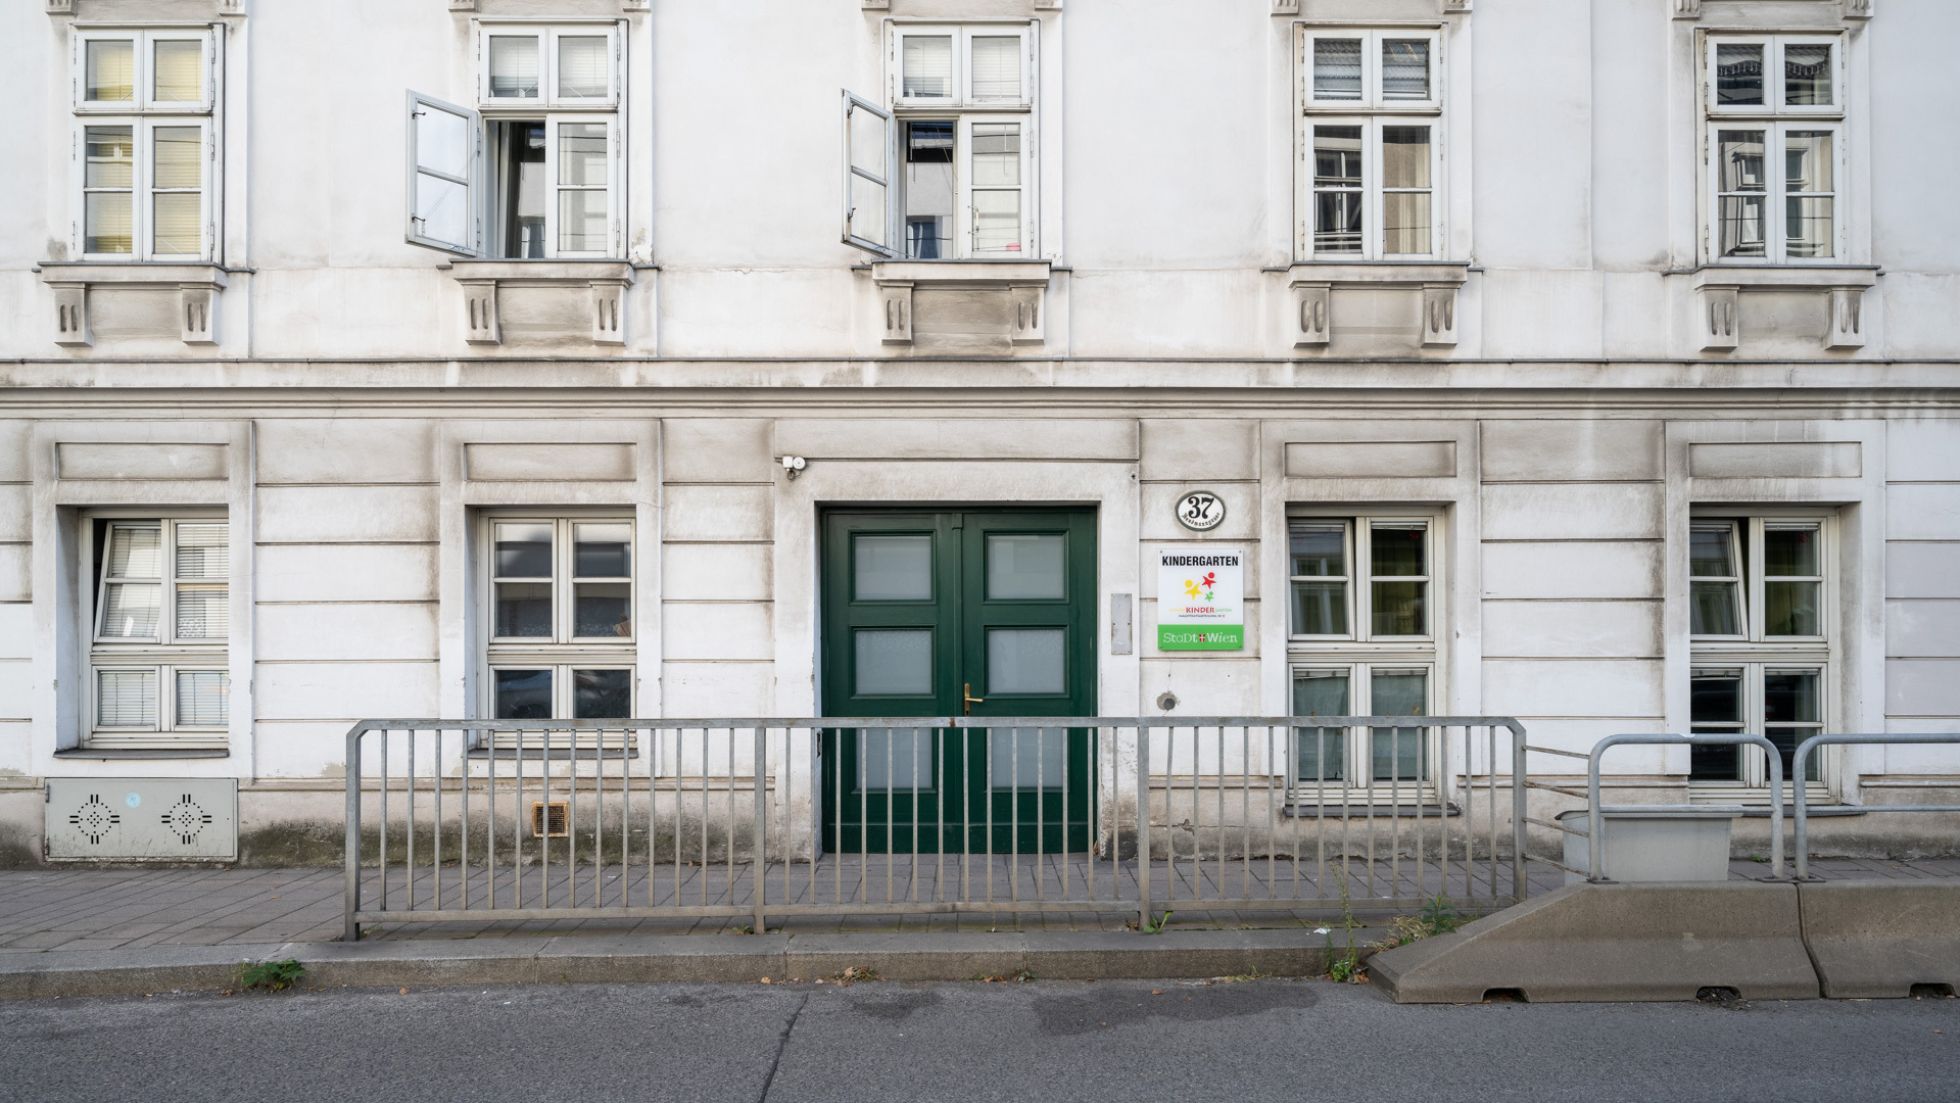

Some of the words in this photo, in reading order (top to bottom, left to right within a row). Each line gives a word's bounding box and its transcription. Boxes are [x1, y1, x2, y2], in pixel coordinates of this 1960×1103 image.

[1188, 496, 1214, 519] 37
[1162, 556, 1239, 567] KINDERGARTEN
[1207, 632, 1238, 643] Wien
